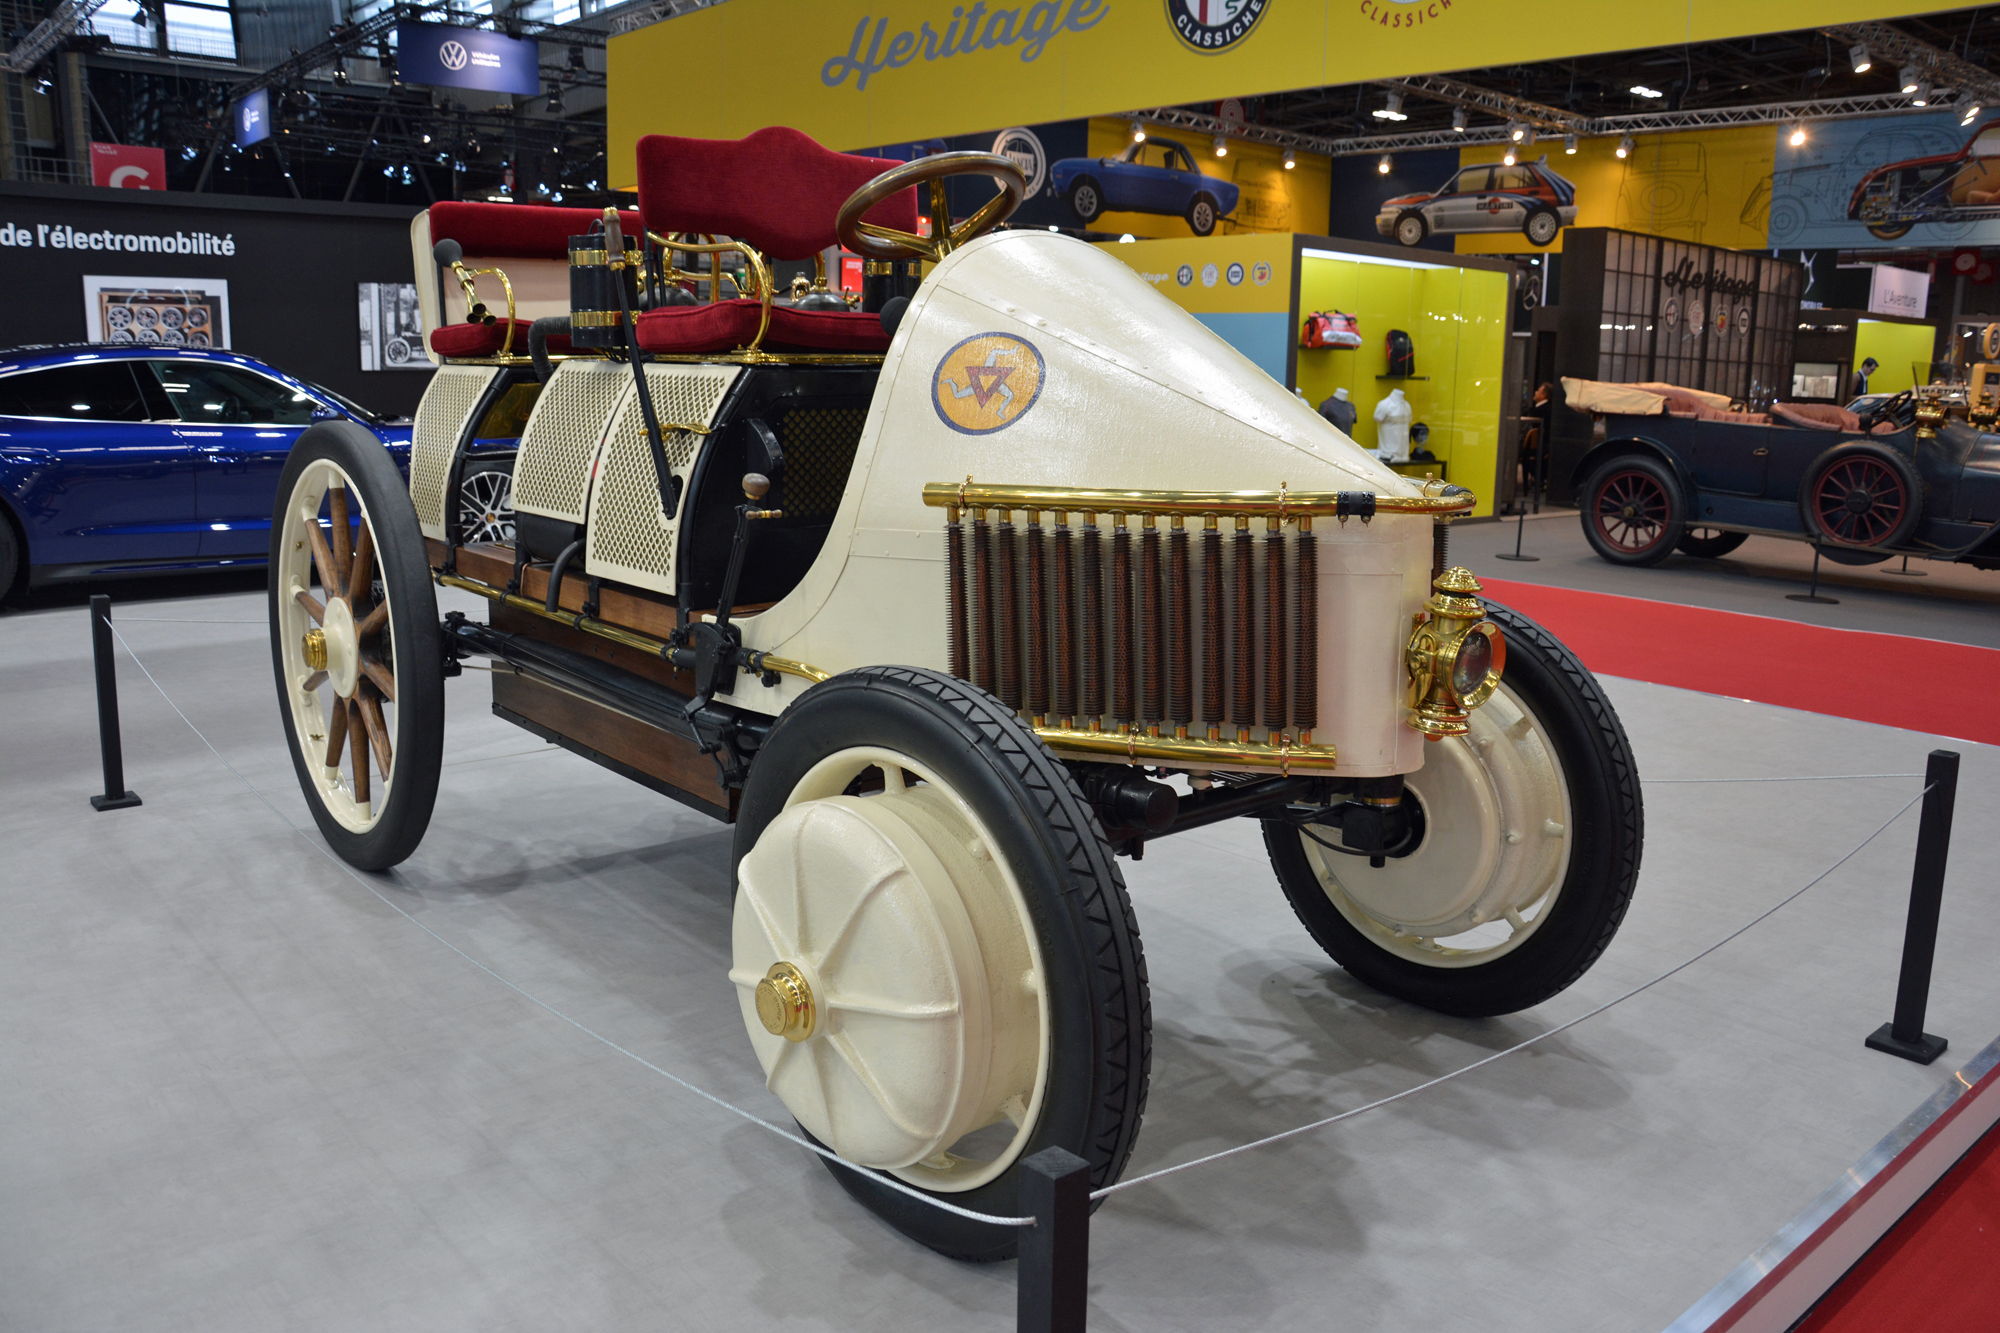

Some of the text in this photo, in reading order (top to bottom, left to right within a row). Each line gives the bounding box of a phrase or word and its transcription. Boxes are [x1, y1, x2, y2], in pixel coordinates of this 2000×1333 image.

[1177, 0, 1262, 46] CLASSICHE
[1360, 0, 1452, 28] CLASSICH
[820, 0, 1111, 92] Heritage
[0, 222, 235, 256] de l'électromobilité
[1664, 256, 1759, 305] Heritage
